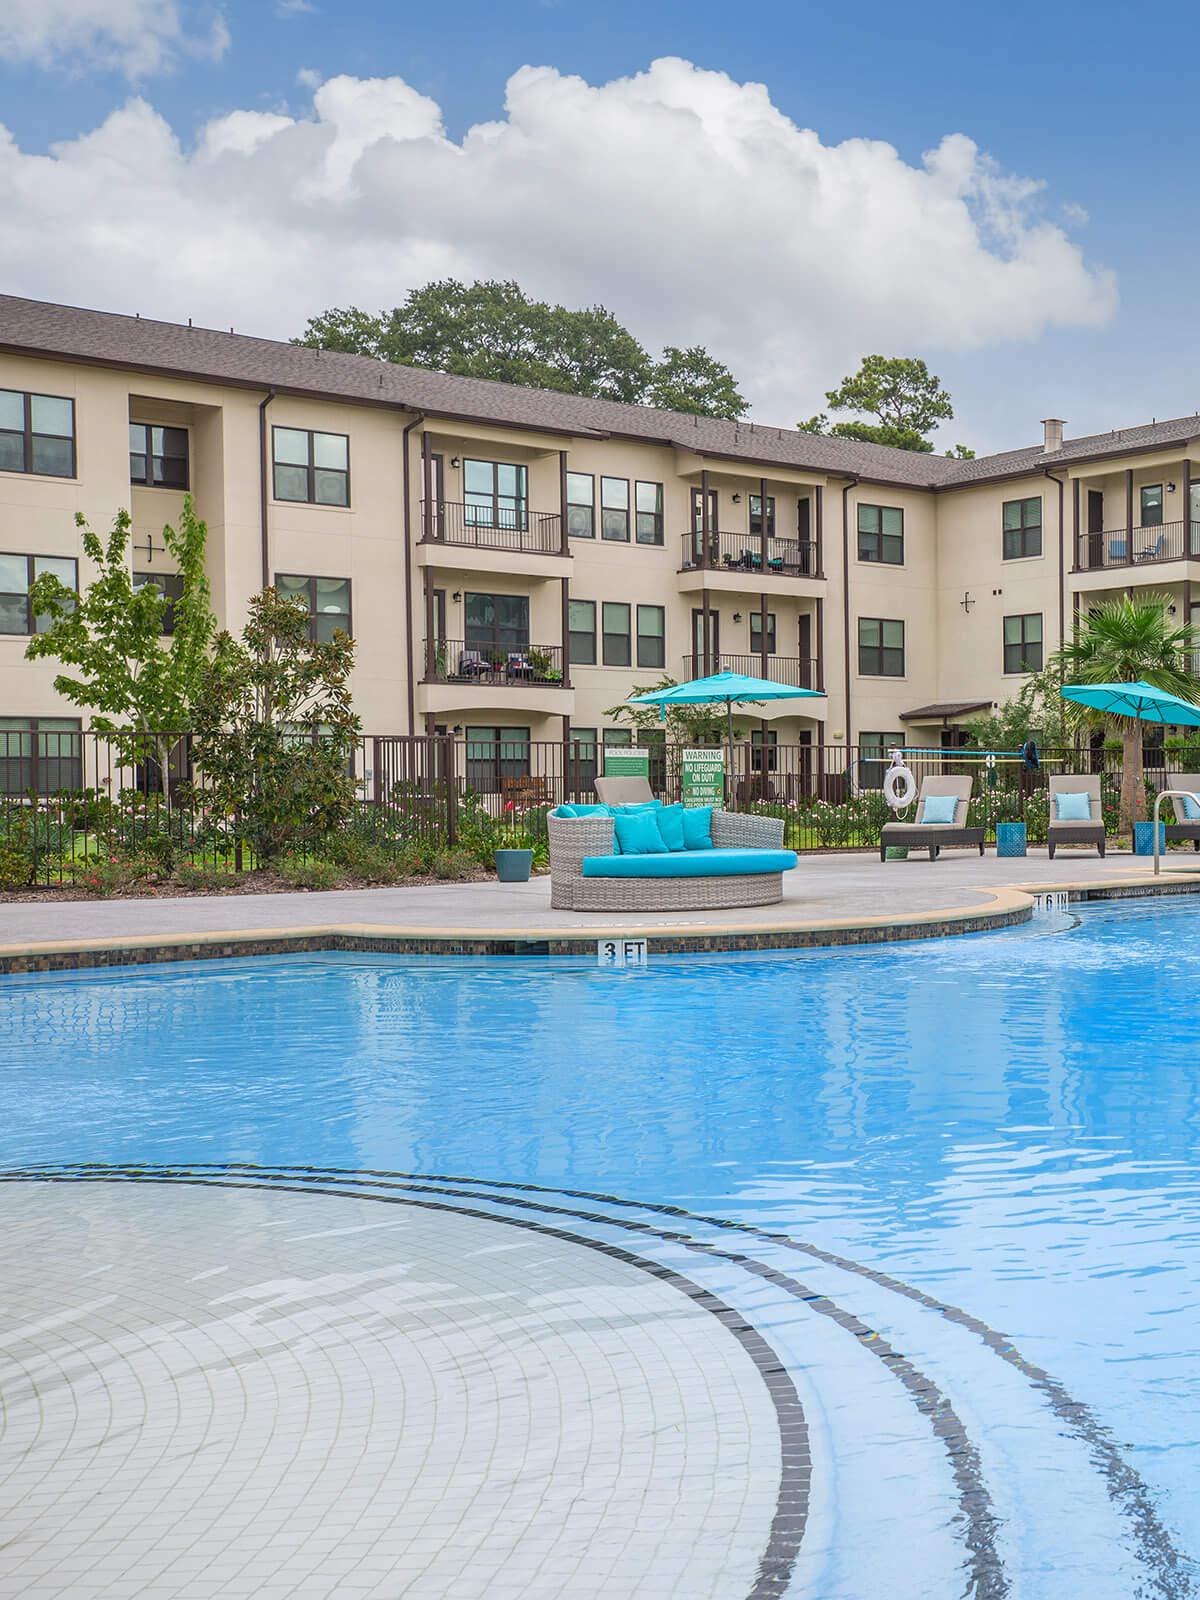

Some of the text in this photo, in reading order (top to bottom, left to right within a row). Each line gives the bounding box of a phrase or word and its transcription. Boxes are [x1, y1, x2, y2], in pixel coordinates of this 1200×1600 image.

[685, 751, 721, 760] WARNING
[685, 763, 721, 772] NO LIFEGUARD
[692, 773, 714, 782] ON DUTY
[692, 787, 715, 796] NO DIVING
[1046, 894, 1052, 906] 6
[1057, 893, 1067, 905] IN
[604, 942, 645, 960] 3 FT
